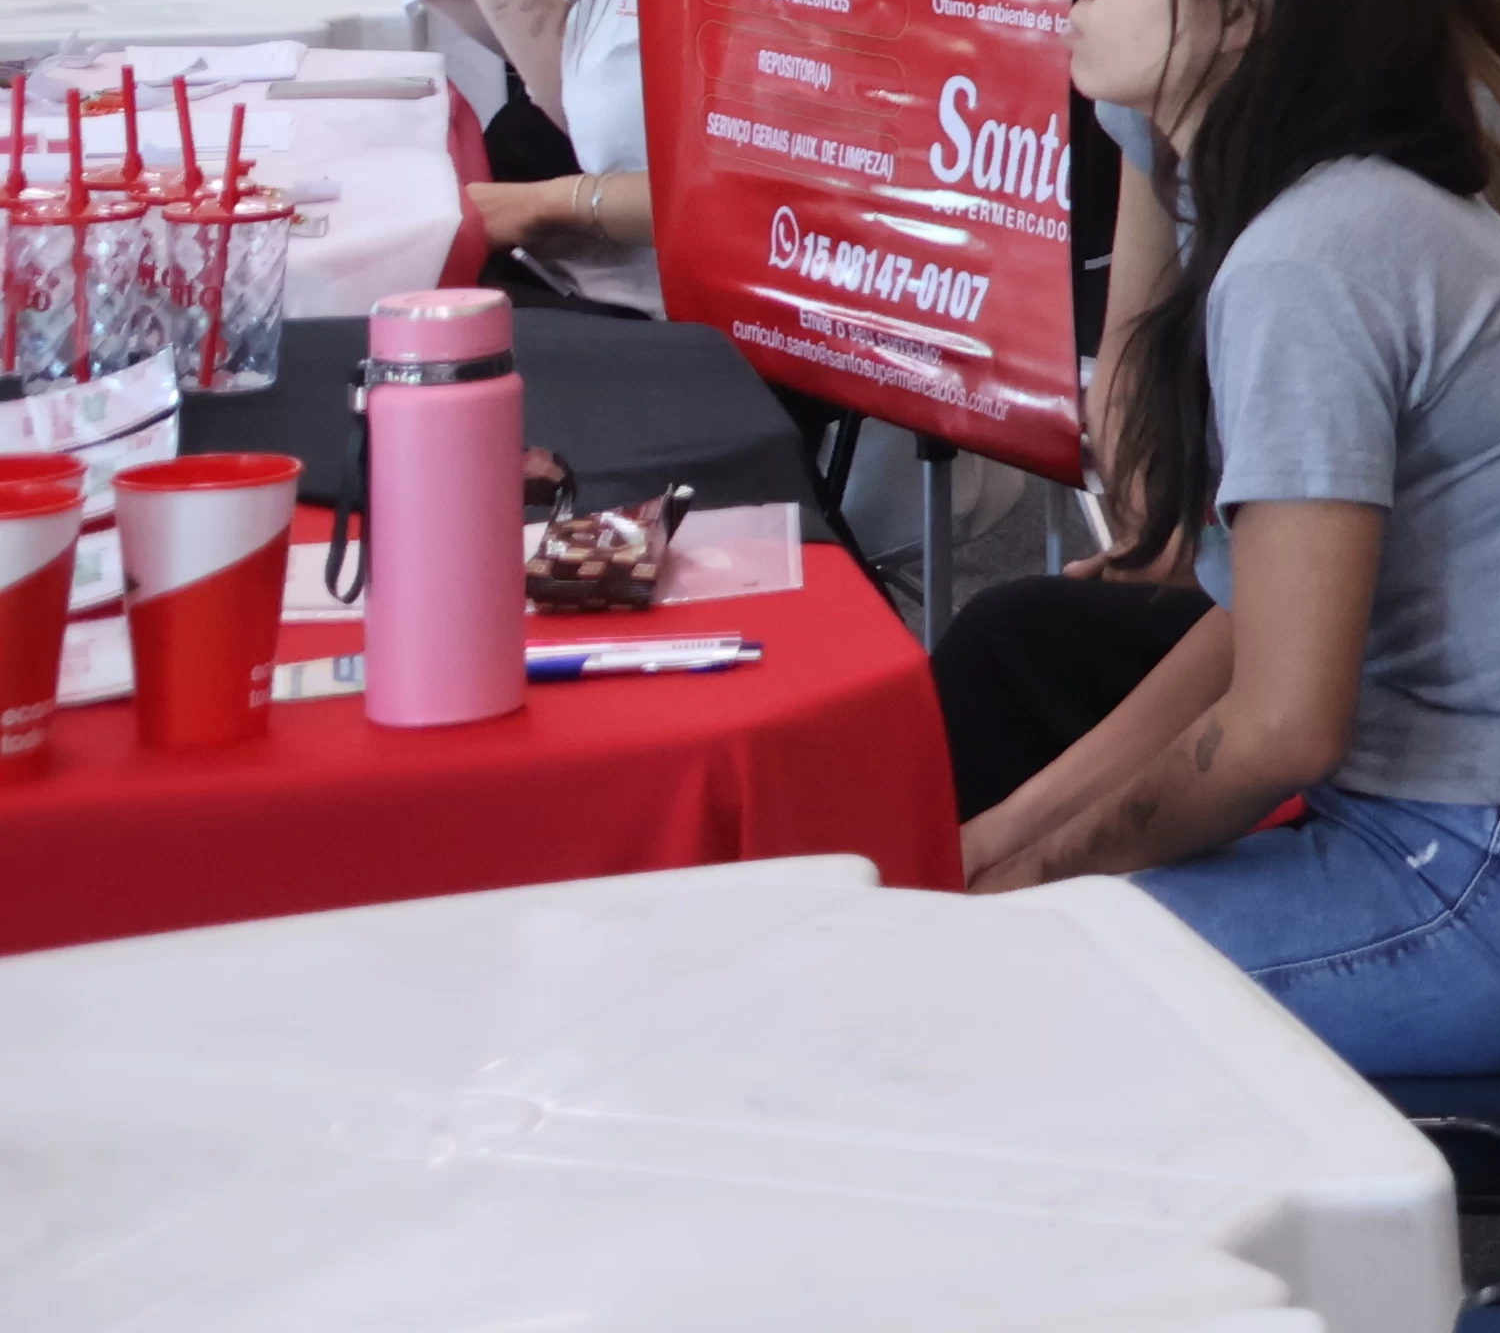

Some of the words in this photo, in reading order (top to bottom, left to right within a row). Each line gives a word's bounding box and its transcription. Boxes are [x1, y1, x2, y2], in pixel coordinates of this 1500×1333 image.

[977, 2, 1036, 27] ambiente
[1037, 10, 1053, 32] de
[757, 49, 832, 92] REPOSITOR(A)
[706, 112, 752, 148] SERVIÇO
[752, 123, 790, 153] GERAIS
[790, 132, 819, 161] (AUX.
[821, 141, 837, 165] DE
[838, 144, 894, 183] LIMPEZA)
[799, 308, 832, 335] Envie
[836, 320, 845, 339] o
[848, 323, 875, 346] seu
